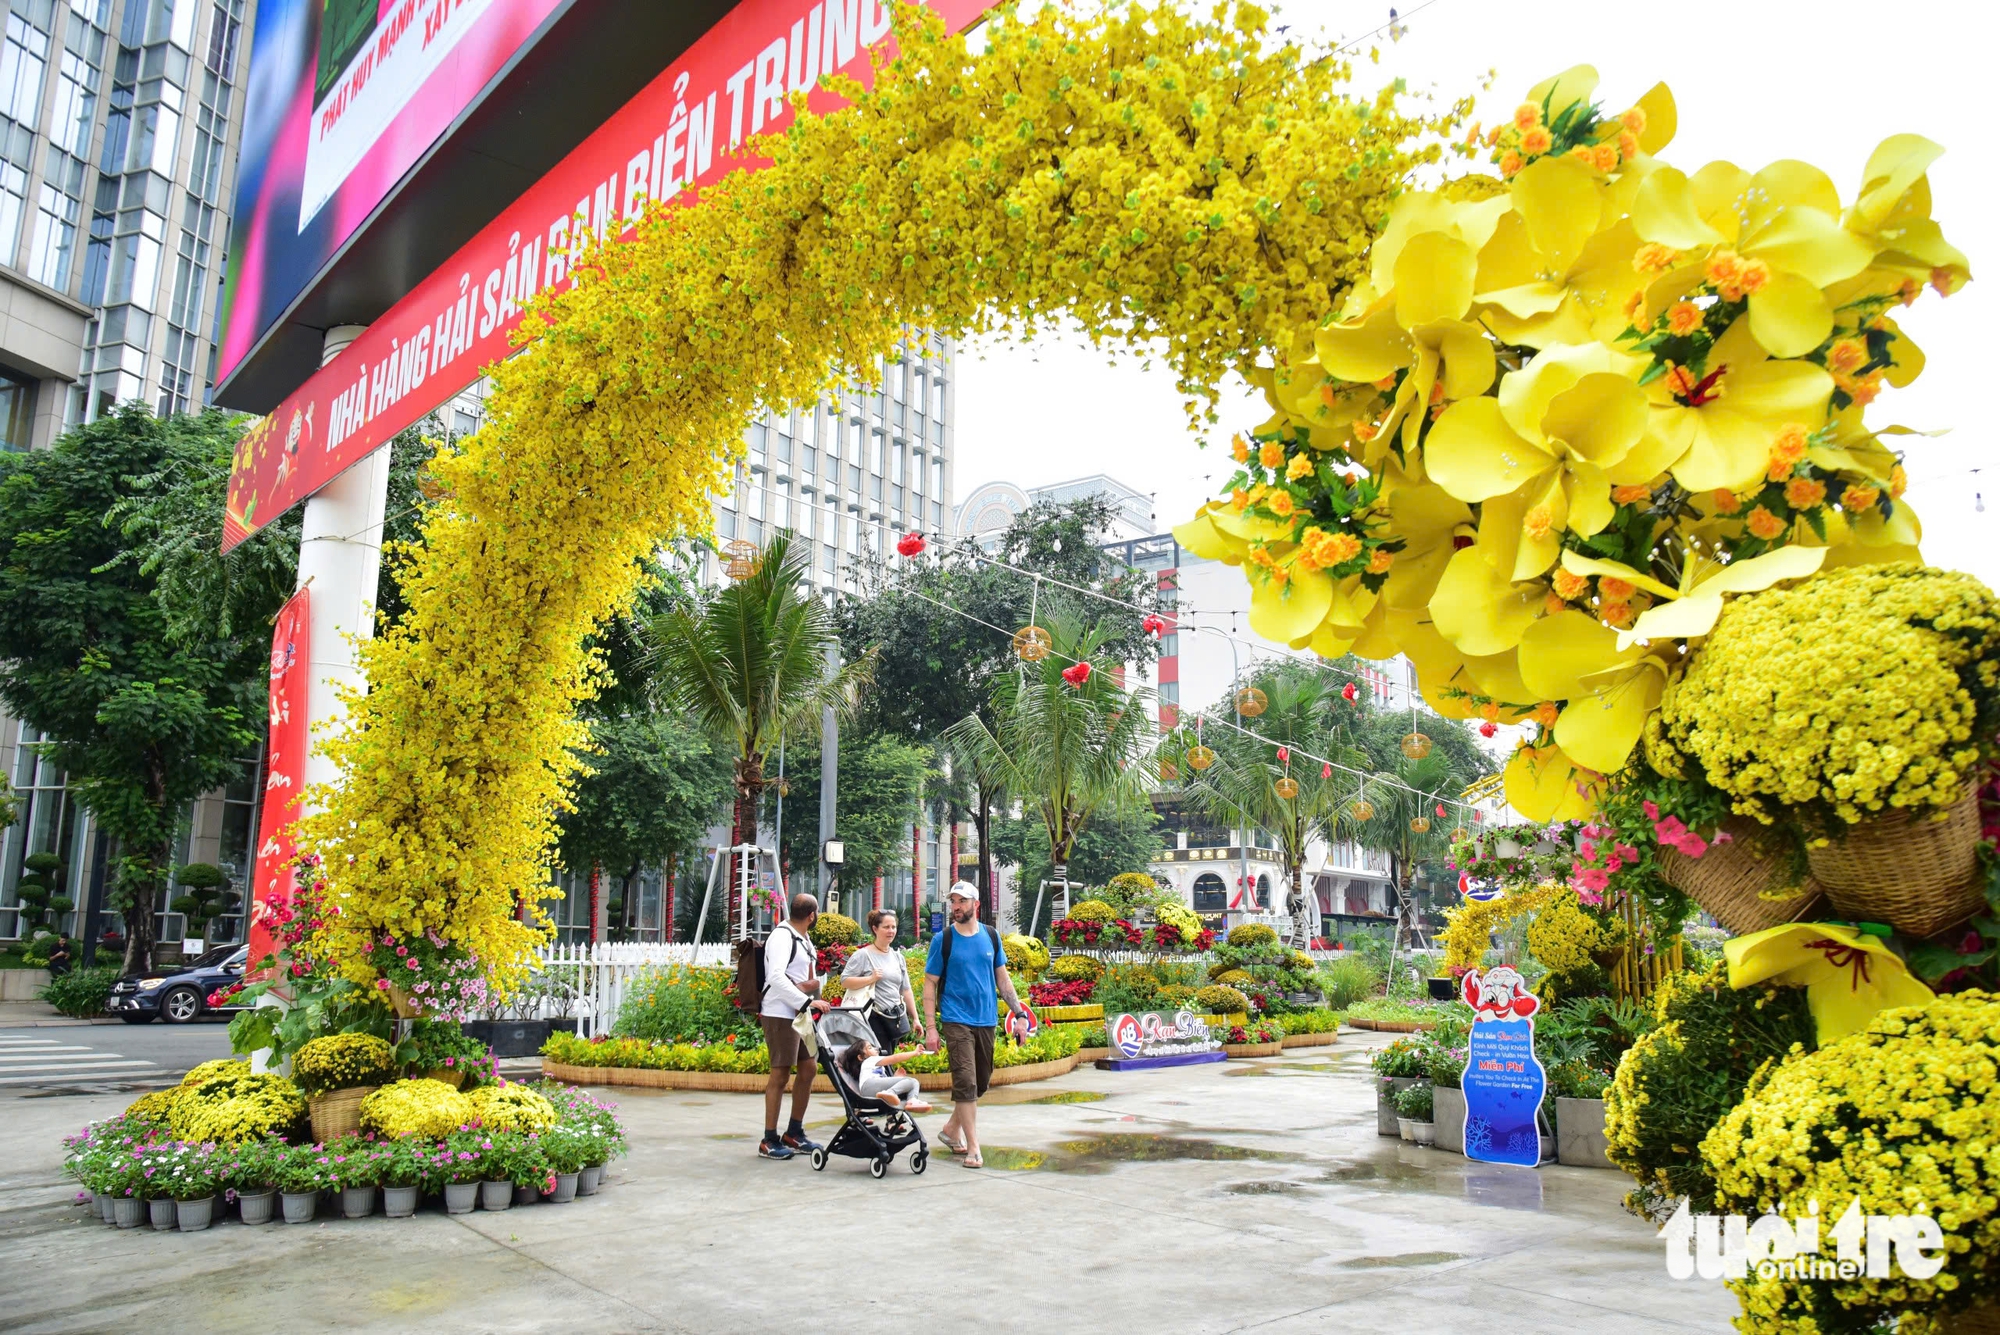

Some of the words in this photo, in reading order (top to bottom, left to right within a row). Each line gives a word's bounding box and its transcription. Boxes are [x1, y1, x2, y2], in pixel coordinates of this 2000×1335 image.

[320, 80, 350, 142] PHÁT
[351, 45, 376, 102] HUY
[376, 0, 415, 68] MẠNH
[326, 364, 369, 453] NHÀ
[369, 323, 431, 421] HÀNG
[431, 272, 477, 376] HẢI
[479, 231, 542, 339] SẢN
[544, 172, 618, 290] RẠN
[621, 71, 716, 234] BIỂN
[1142, 1013, 1177, 1044] Rạn
[1176, 1011, 1209, 1039] Biển
[1478, 1059, 1504, 1071] Miễn
[1506, 1061, 1524, 1073] Phí
